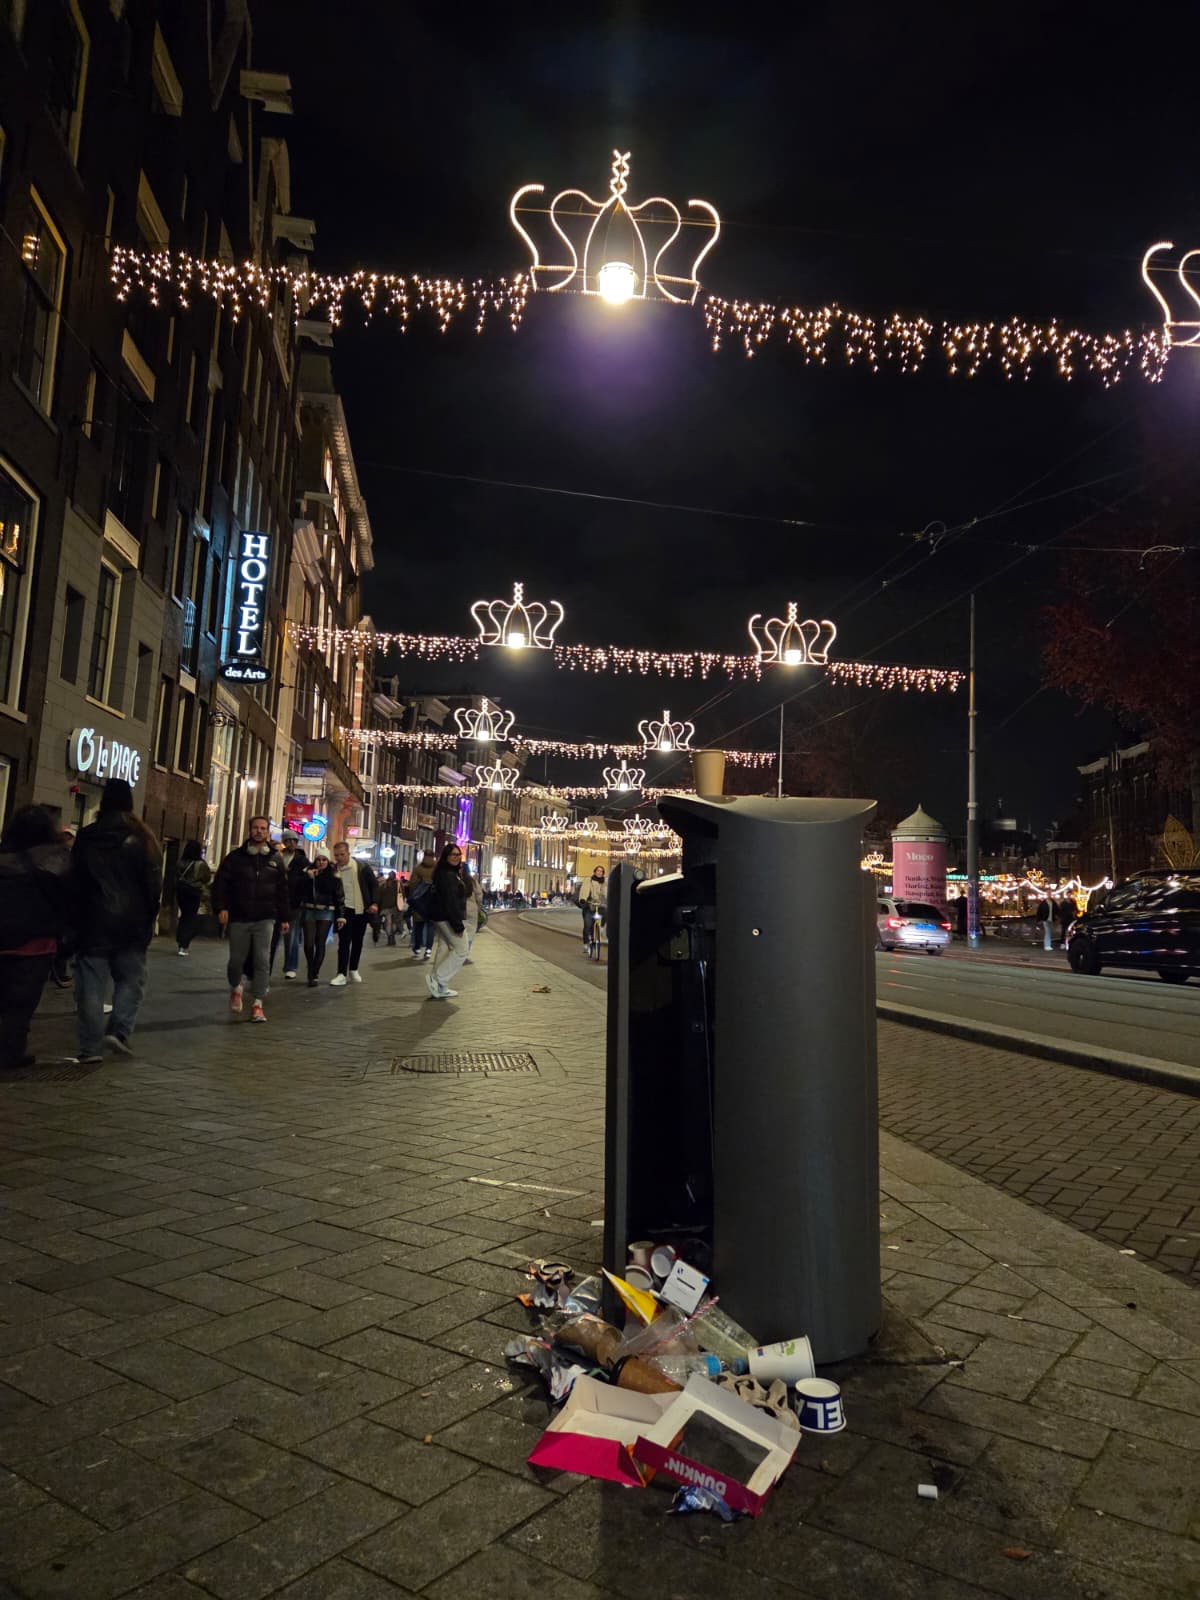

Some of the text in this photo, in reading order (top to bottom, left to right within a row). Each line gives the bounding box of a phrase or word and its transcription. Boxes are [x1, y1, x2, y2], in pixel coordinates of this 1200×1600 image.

[237, 533, 269, 655] HOTEL
[225, 667, 266, 680] des Arts
